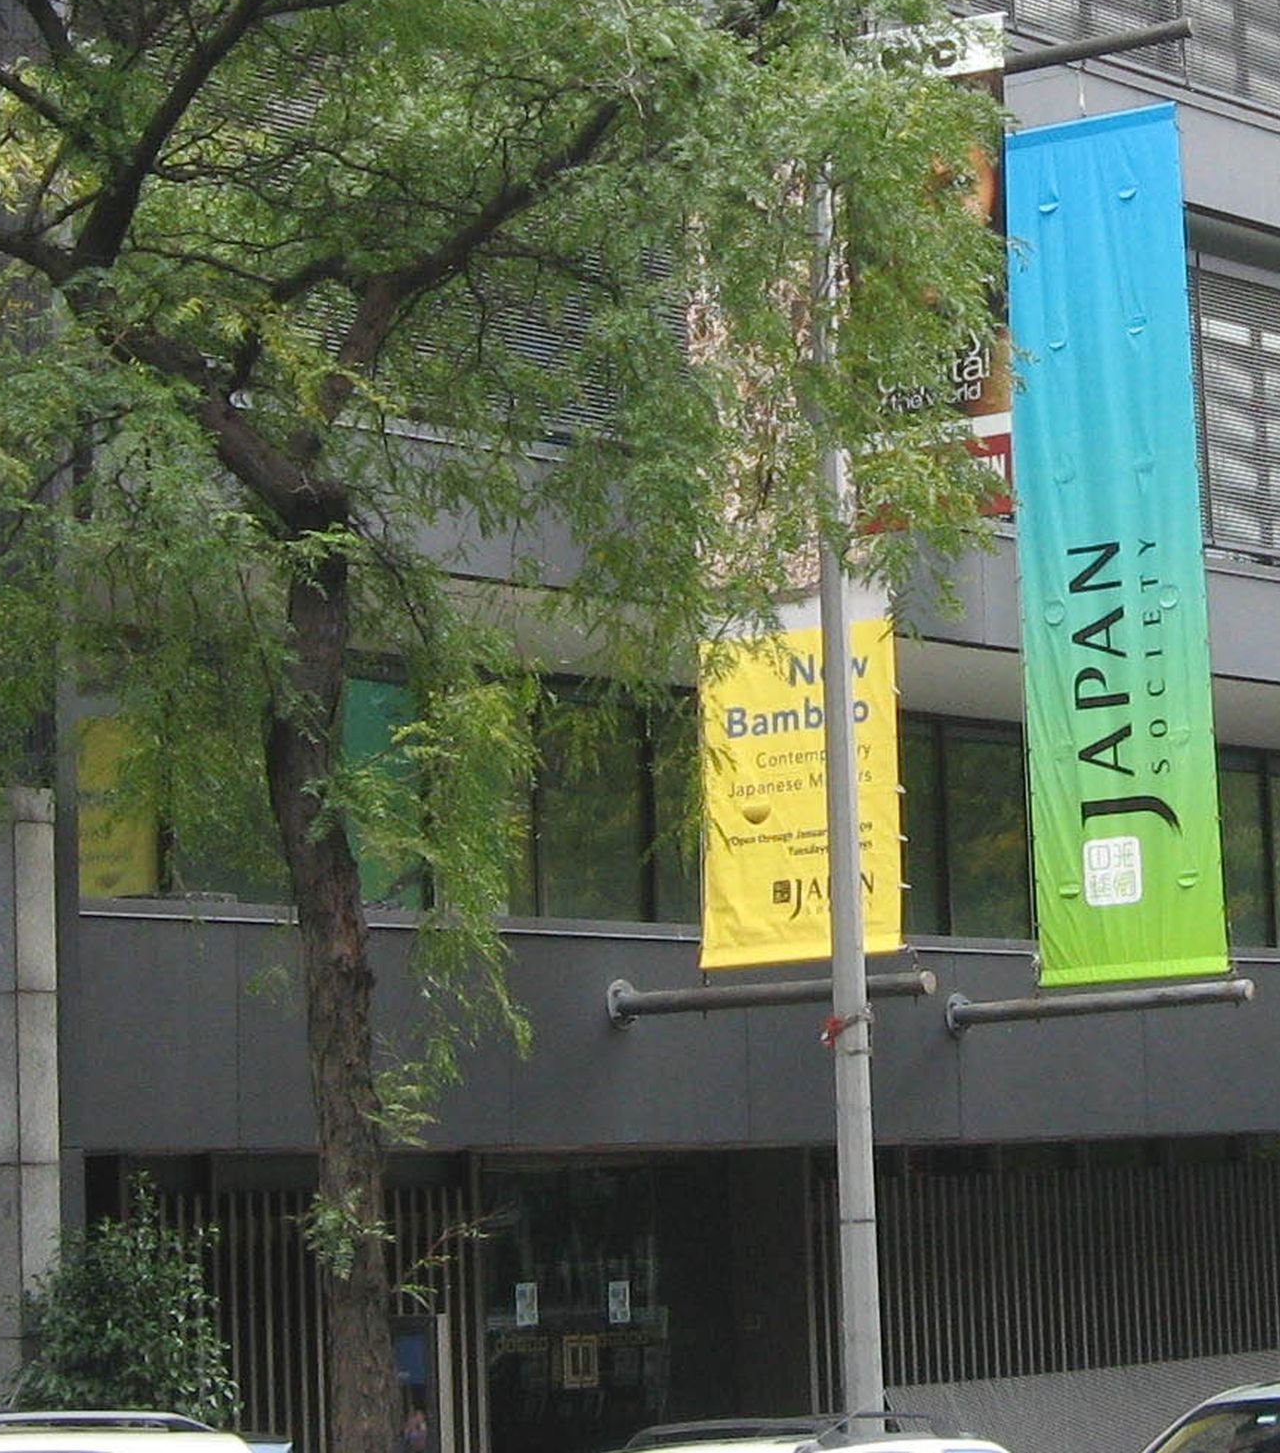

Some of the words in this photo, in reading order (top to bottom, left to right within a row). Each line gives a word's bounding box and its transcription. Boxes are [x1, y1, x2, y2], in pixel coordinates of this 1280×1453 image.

[788, 653, 869, 687] Nw
[1137, 538, 1170, 775] SOCIETY
[1066, 541, 1183, 835] JAPAN
[725, 696, 870, 740] Bambo
[727, 778, 802, 799] Japanese
[788, 870, 875, 922] JAN
